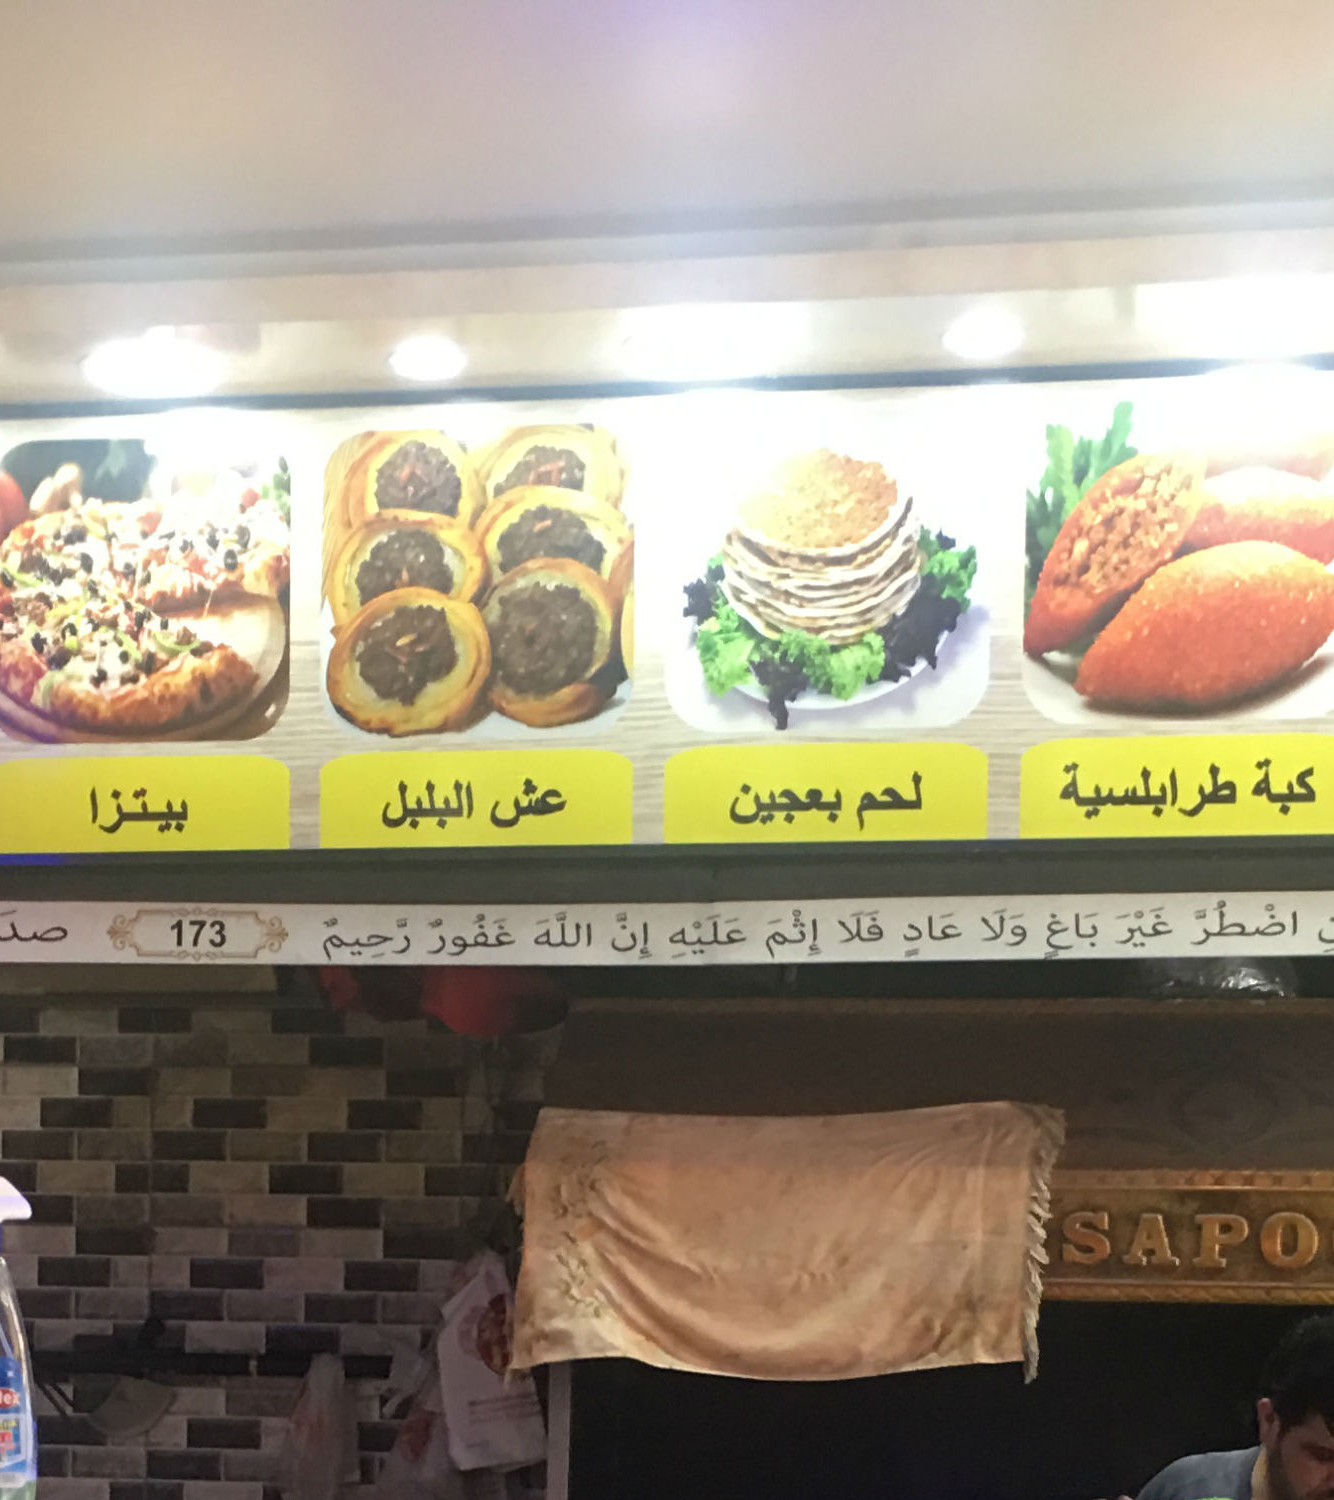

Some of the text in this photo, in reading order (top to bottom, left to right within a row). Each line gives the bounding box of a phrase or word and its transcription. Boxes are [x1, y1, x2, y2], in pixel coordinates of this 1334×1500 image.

[91, 786, 188, 833] بيتزا
[382, 779, 566, 829] عش البلبل
[730, 772, 922, 829] لحم بعجين
[1060, 759, 1315, 819] كبة طرابلسية
[170, 919, 227, 948] 173
